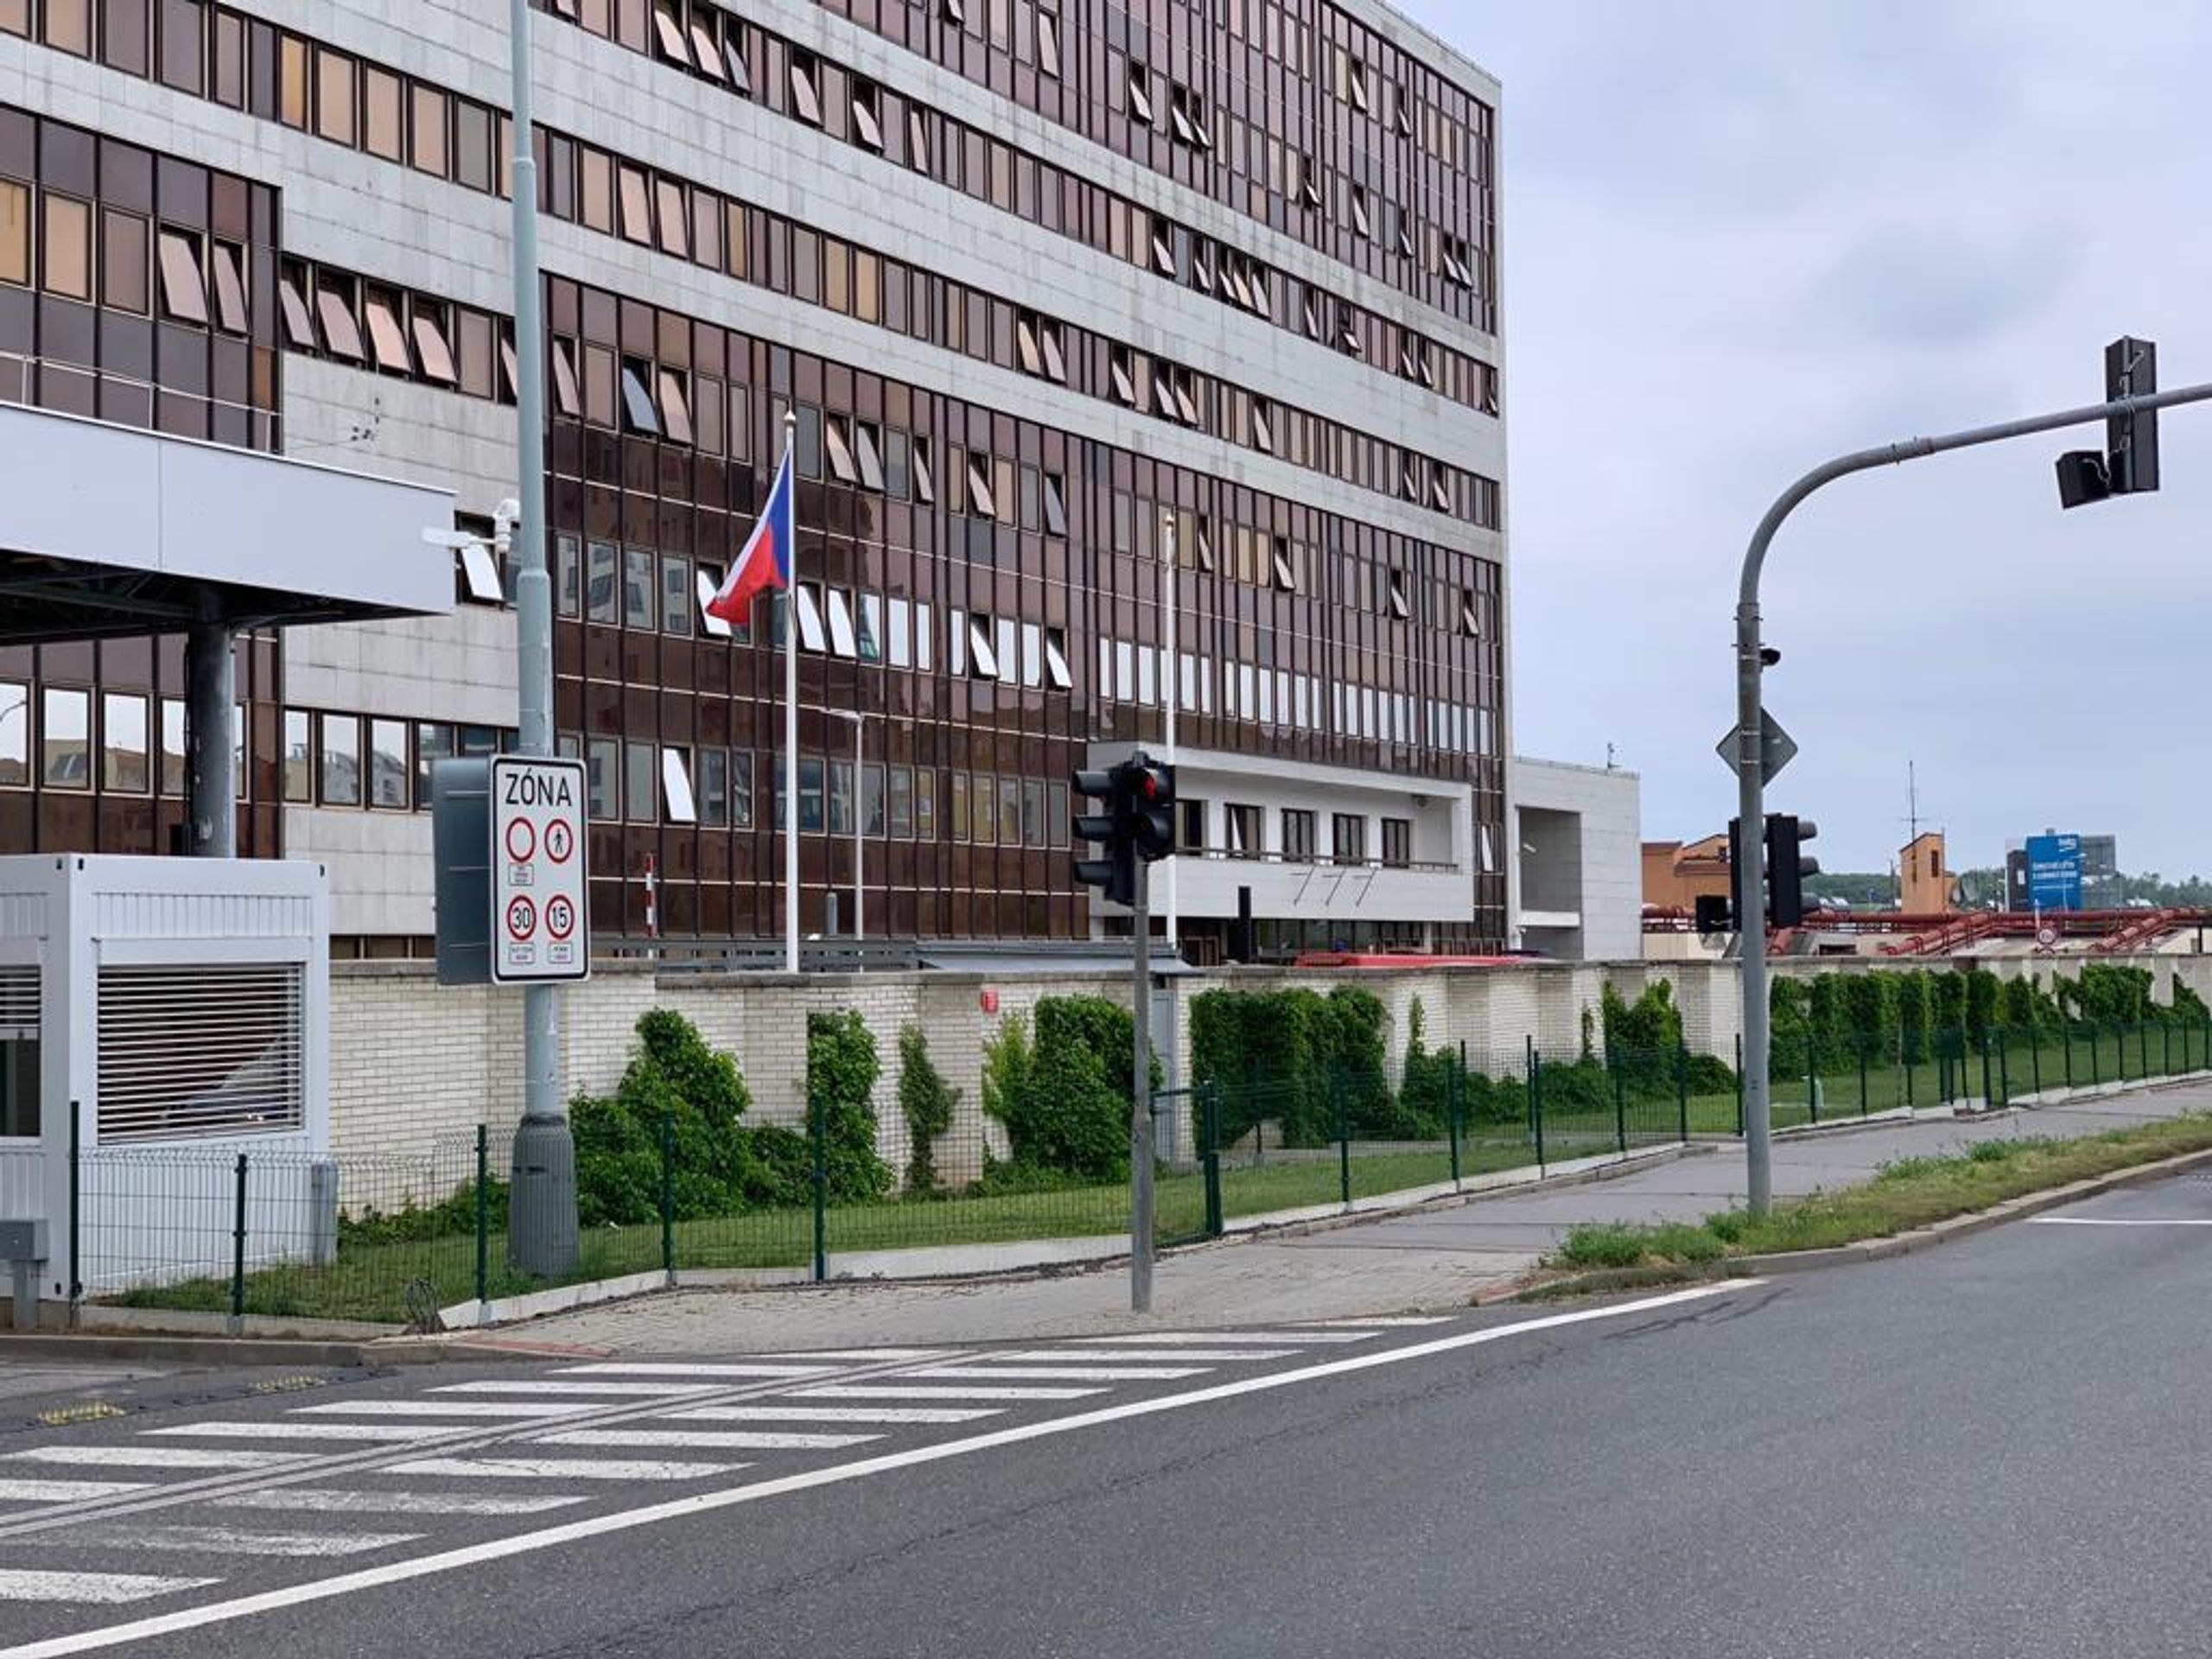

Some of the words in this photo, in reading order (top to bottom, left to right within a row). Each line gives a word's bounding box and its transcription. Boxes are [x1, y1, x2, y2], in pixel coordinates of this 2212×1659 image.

[505, 767, 571, 806] ZÓNA
[513, 907, 530, 929] 30
[552, 906, 567, 928] 15
